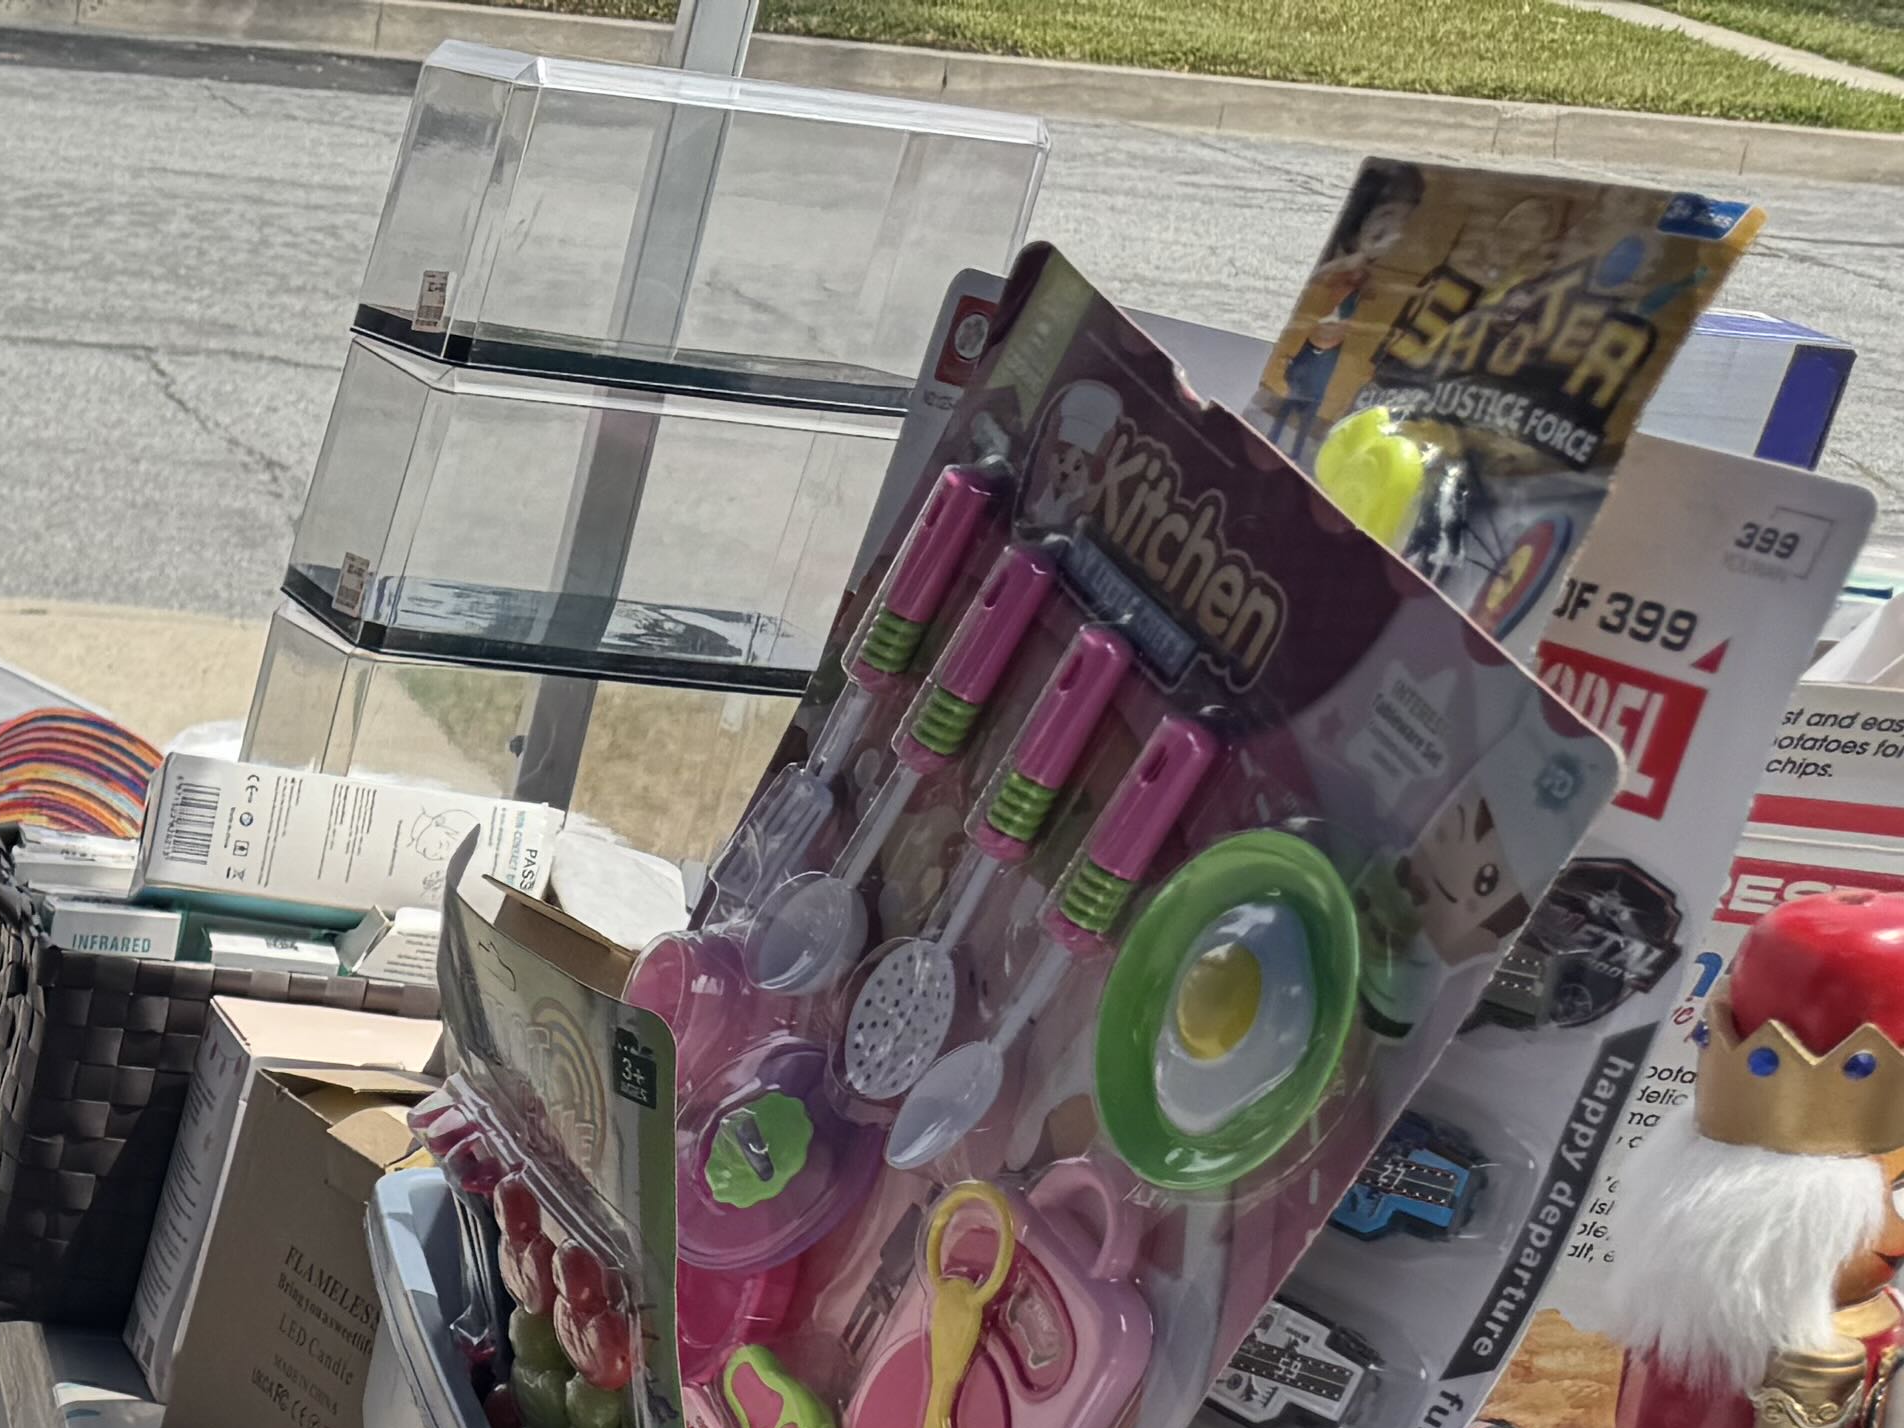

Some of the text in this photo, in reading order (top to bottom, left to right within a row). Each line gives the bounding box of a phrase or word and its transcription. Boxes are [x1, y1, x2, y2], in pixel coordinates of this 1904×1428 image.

[1431, 382, 1599, 463] JUSTICE FORCE
[1098, 432, 1279, 670] Kitchen
[1734, 521, 1804, 560] 399
[1595, 591, 1698, 653] 399
[1772, 732, 1868, 757] otatoes
[1808, 709, 1904, 736] and eas
[1766, 755, 1834, 779] chips.
[71, 932, 152, 953] INFRARED
[620, 1056, 649, 1087] 3+
[1558, 1052, 1636, 1177] happy
[1471, 1181, 1594, 1360] departure
[278, 1312, 354, 1386] LED Candle
